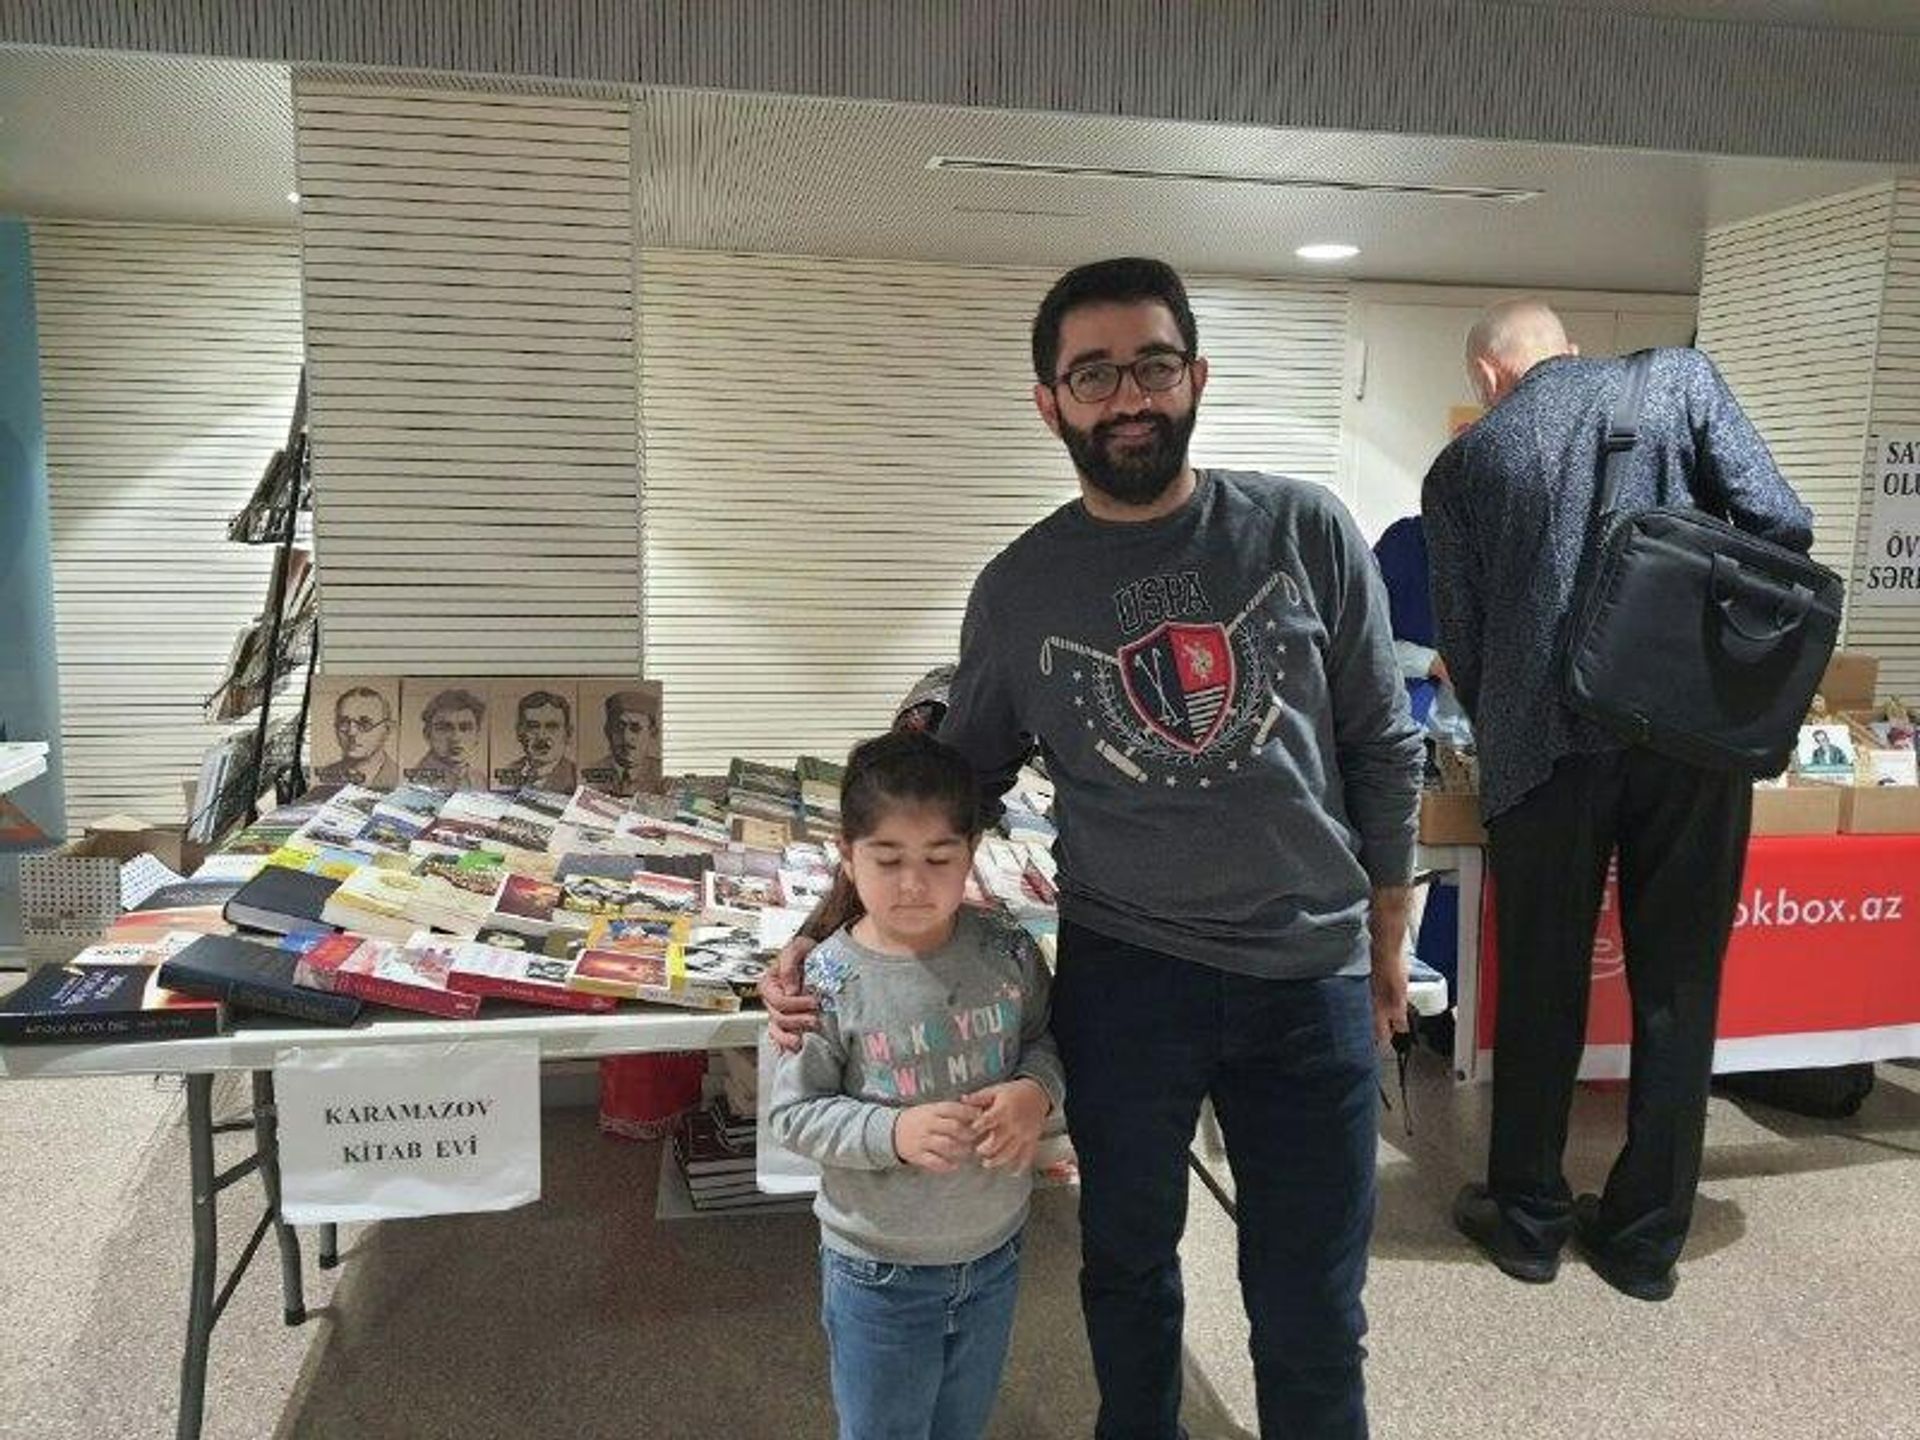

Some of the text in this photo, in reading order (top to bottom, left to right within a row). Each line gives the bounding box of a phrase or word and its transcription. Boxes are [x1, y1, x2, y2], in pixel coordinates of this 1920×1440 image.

[1867, 566, 1920, 589] SƏR
[1112, 571, 1213, 634] USPA
[325, 1097, 491, 1125] KARAMAZOV
[343, 1135, 477, 1163] KİTAB EVİ
